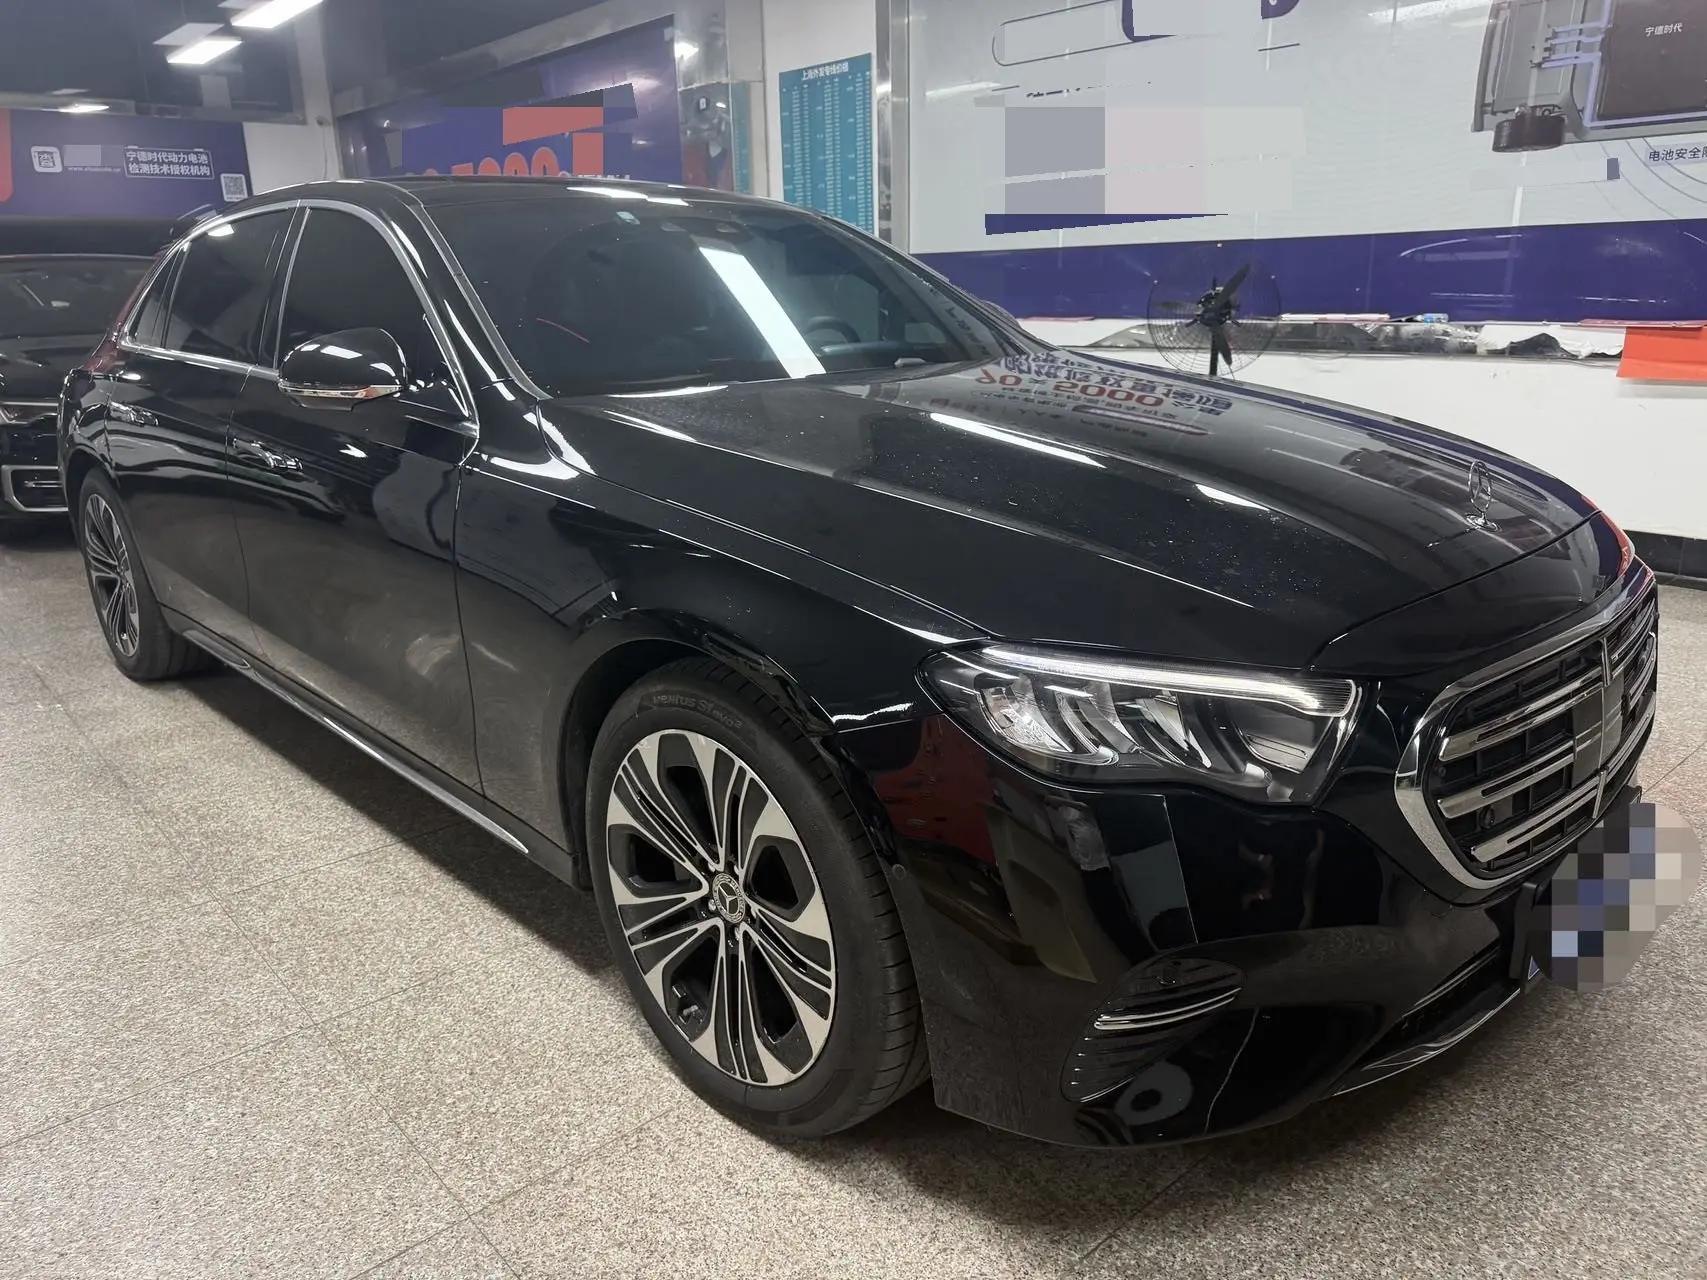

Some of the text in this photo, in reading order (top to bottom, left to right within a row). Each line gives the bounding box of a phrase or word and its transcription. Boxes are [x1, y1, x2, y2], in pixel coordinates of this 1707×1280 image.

[1645, 22, 1683, 37] 宁德时代
[126, 151, 208, 164] 宁德时代动力电池
[128, 163, 210, 176] 检测技术授权机构
